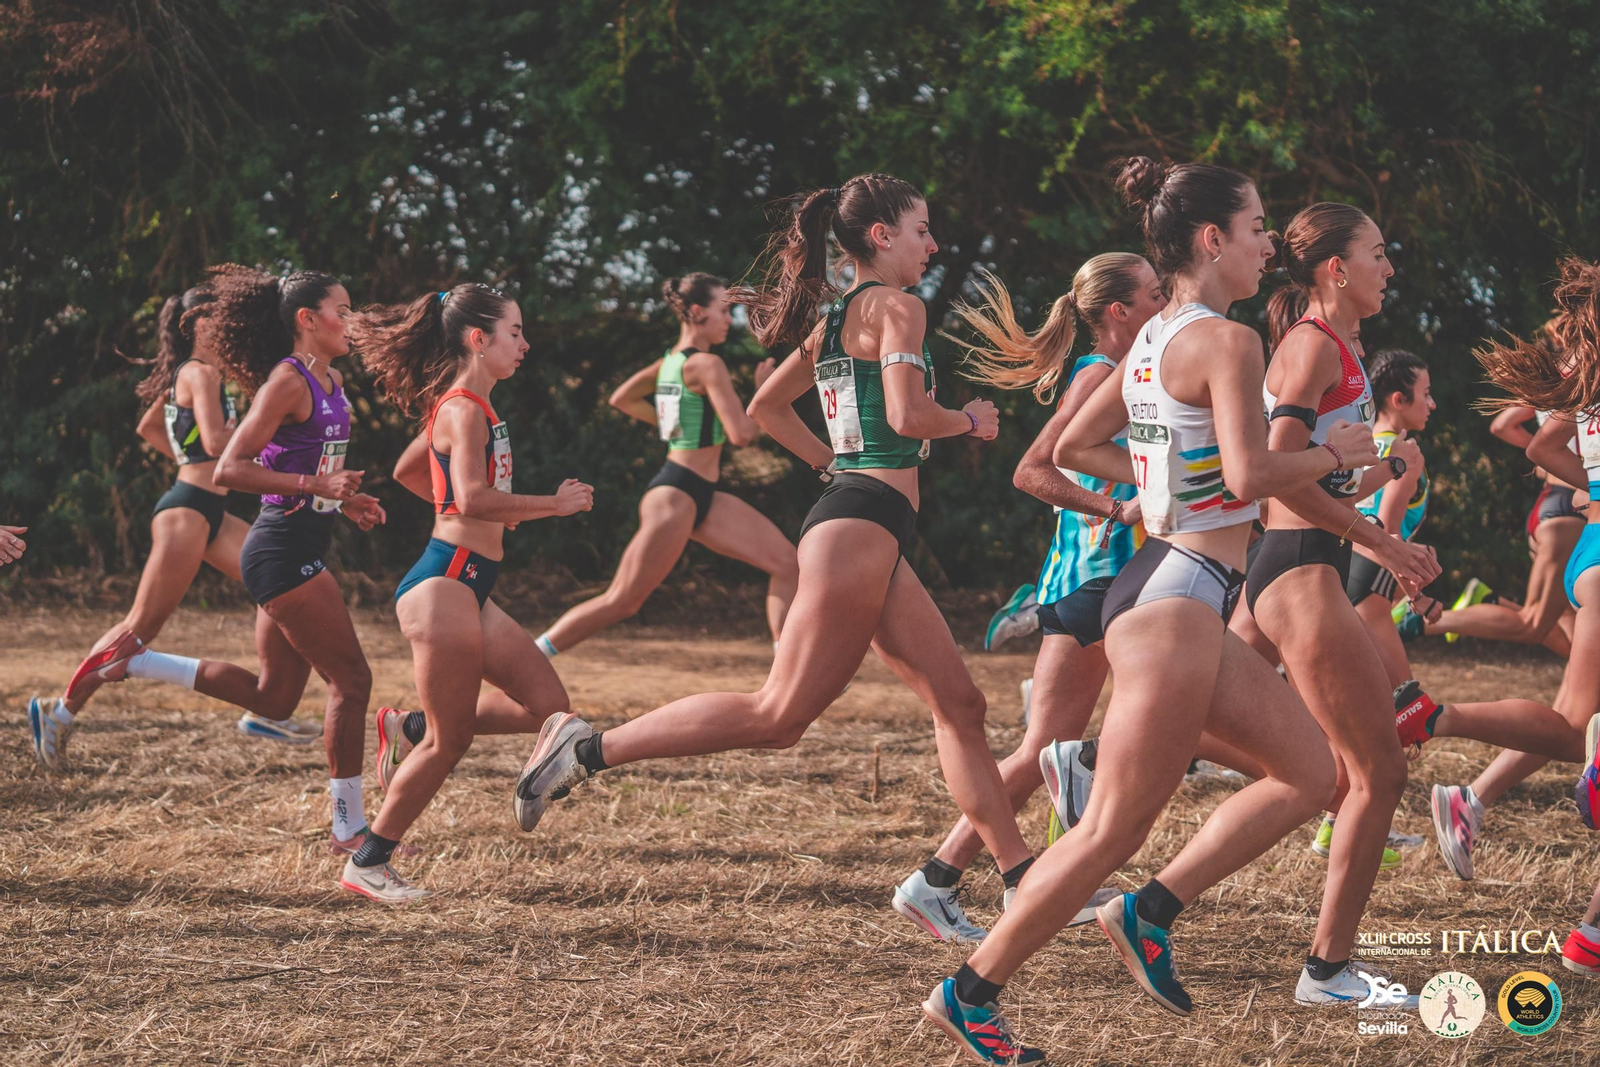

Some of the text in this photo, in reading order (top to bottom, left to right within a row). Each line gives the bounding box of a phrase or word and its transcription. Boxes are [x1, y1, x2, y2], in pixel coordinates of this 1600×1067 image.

[824, 388, 837, 419] 29
[1131, 398, 1158, 419] ATLÉTICO
[336, 797, 348, 825] 42K
